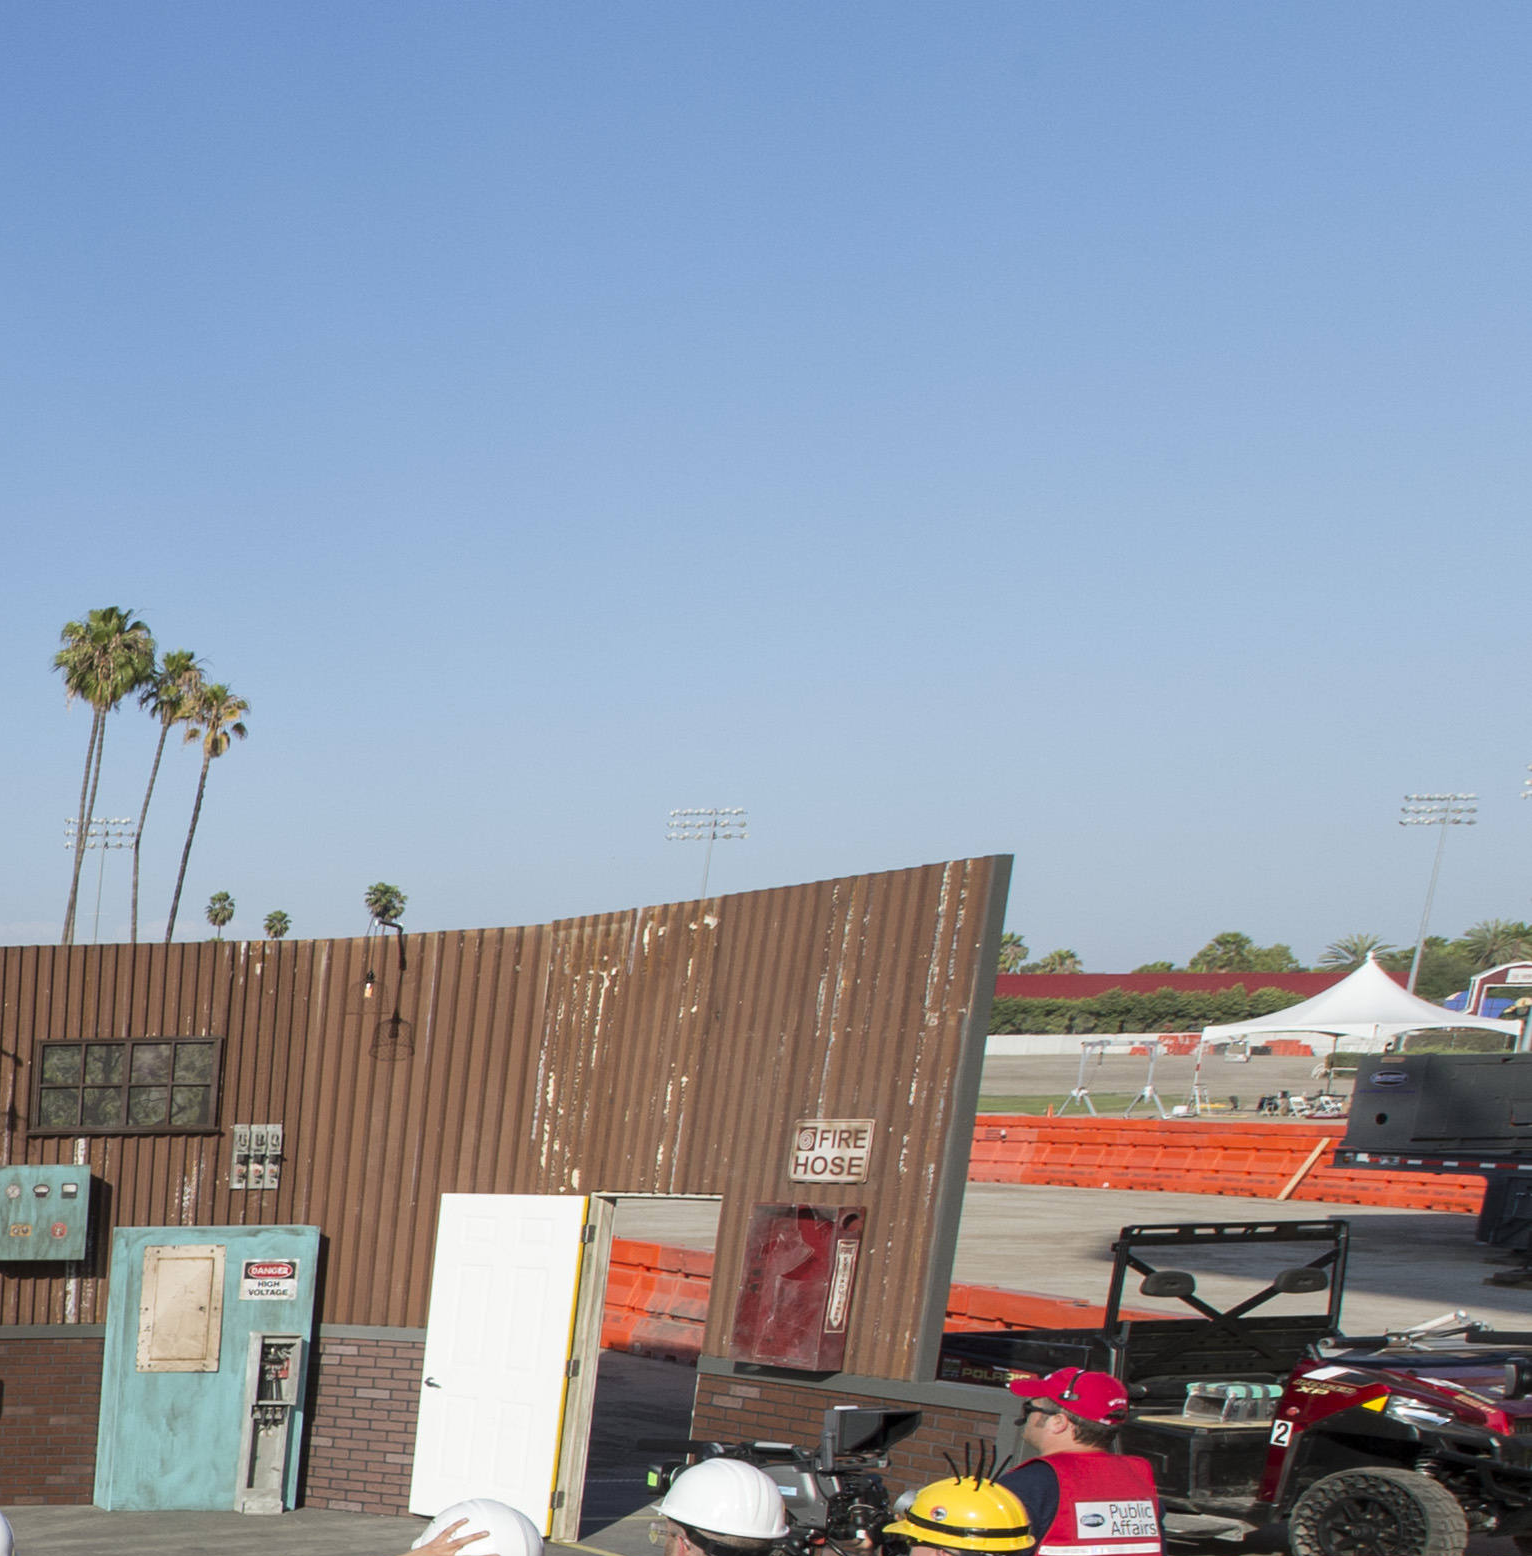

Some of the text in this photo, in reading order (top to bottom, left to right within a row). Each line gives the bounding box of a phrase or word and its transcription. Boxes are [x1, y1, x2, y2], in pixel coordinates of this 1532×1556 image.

[818, 1129, 868, 1149] FIRE
[793, 1155, 864, 1176] HOSE
[251, 1267, 289, 1275] DANGER
[1273, 1422, 1289, 1445] 2
[1109, 1503, 1153, 1519] Public
[1111, 1520, 1156, 1536] Affairs
